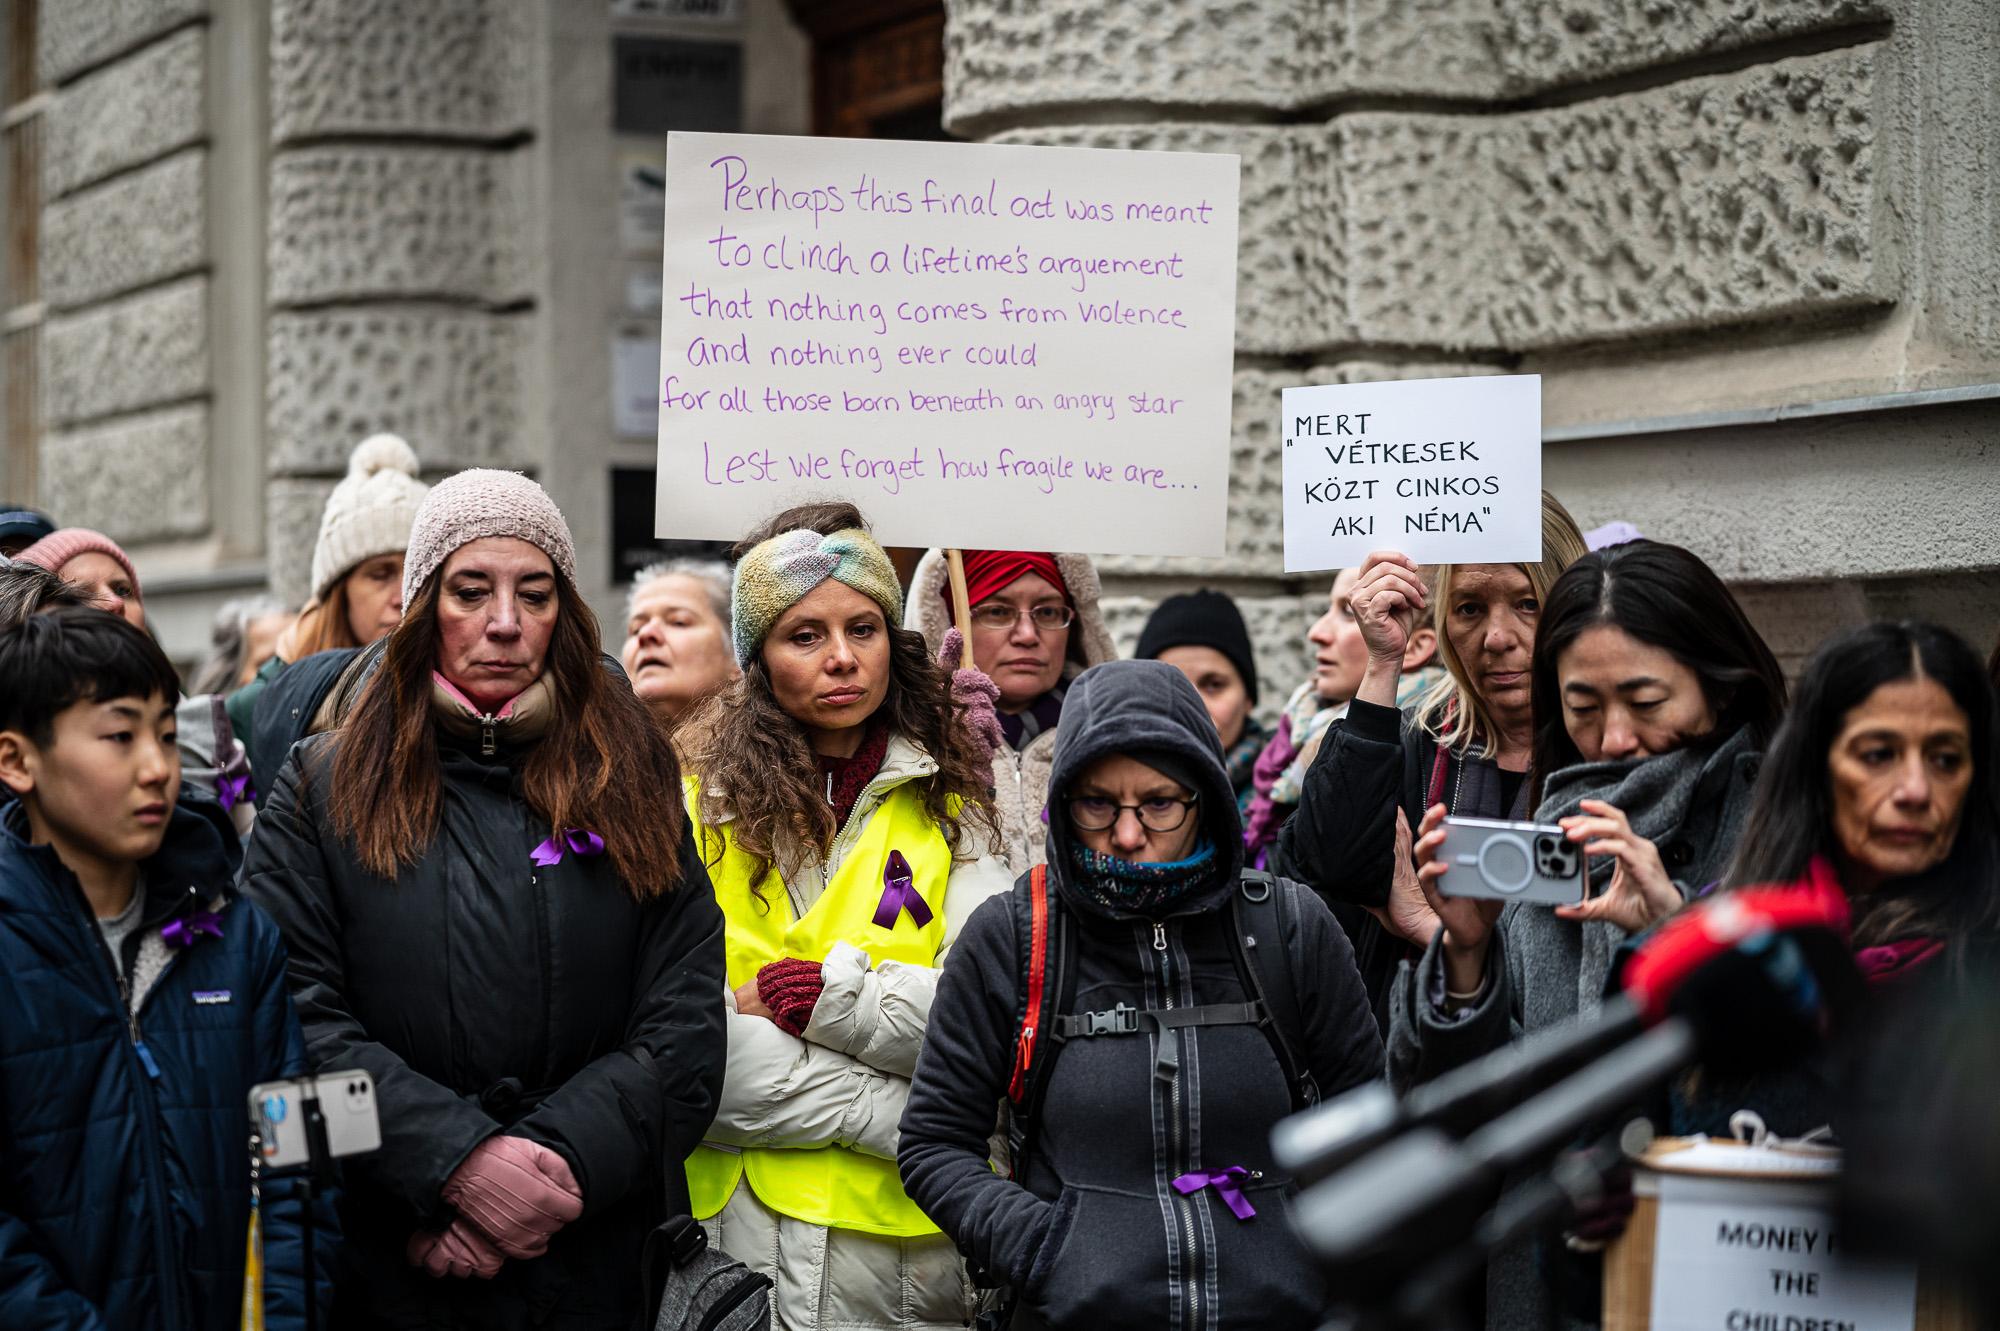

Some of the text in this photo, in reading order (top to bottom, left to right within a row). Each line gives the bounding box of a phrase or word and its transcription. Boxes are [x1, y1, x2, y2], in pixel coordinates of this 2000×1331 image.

[710, 156, 1212, 230] Perhaps this final act was meant
[708, 226, 1183, 292] to clinch a lifetime's arguement
[680, 282, 752, 320] that
[768, 292, 886, 334] nothing
[897, 302, 987, 321] comes
[1000, 298, 1067, 323] from
[687, 334, 1035, 373] and nothing ever could
[663, 376, 1184, 420] for all those born beneath an angry star
[704, 442, 777, 485] Lest
[841, 448, 924, 495] forget
[938, 448, 987, 479] how
[997, 448, 1073, 494] fragile
[1324, 439, 1480, 465] VÉTKESEK
[1305, 475, 1500, 504] KÖZT CINKOS
[1331, 515, 1374, 537] AKI
[1716, 1220, 1819, 1254] MONEY
[1769, 1268, 1819, 1297] THE
